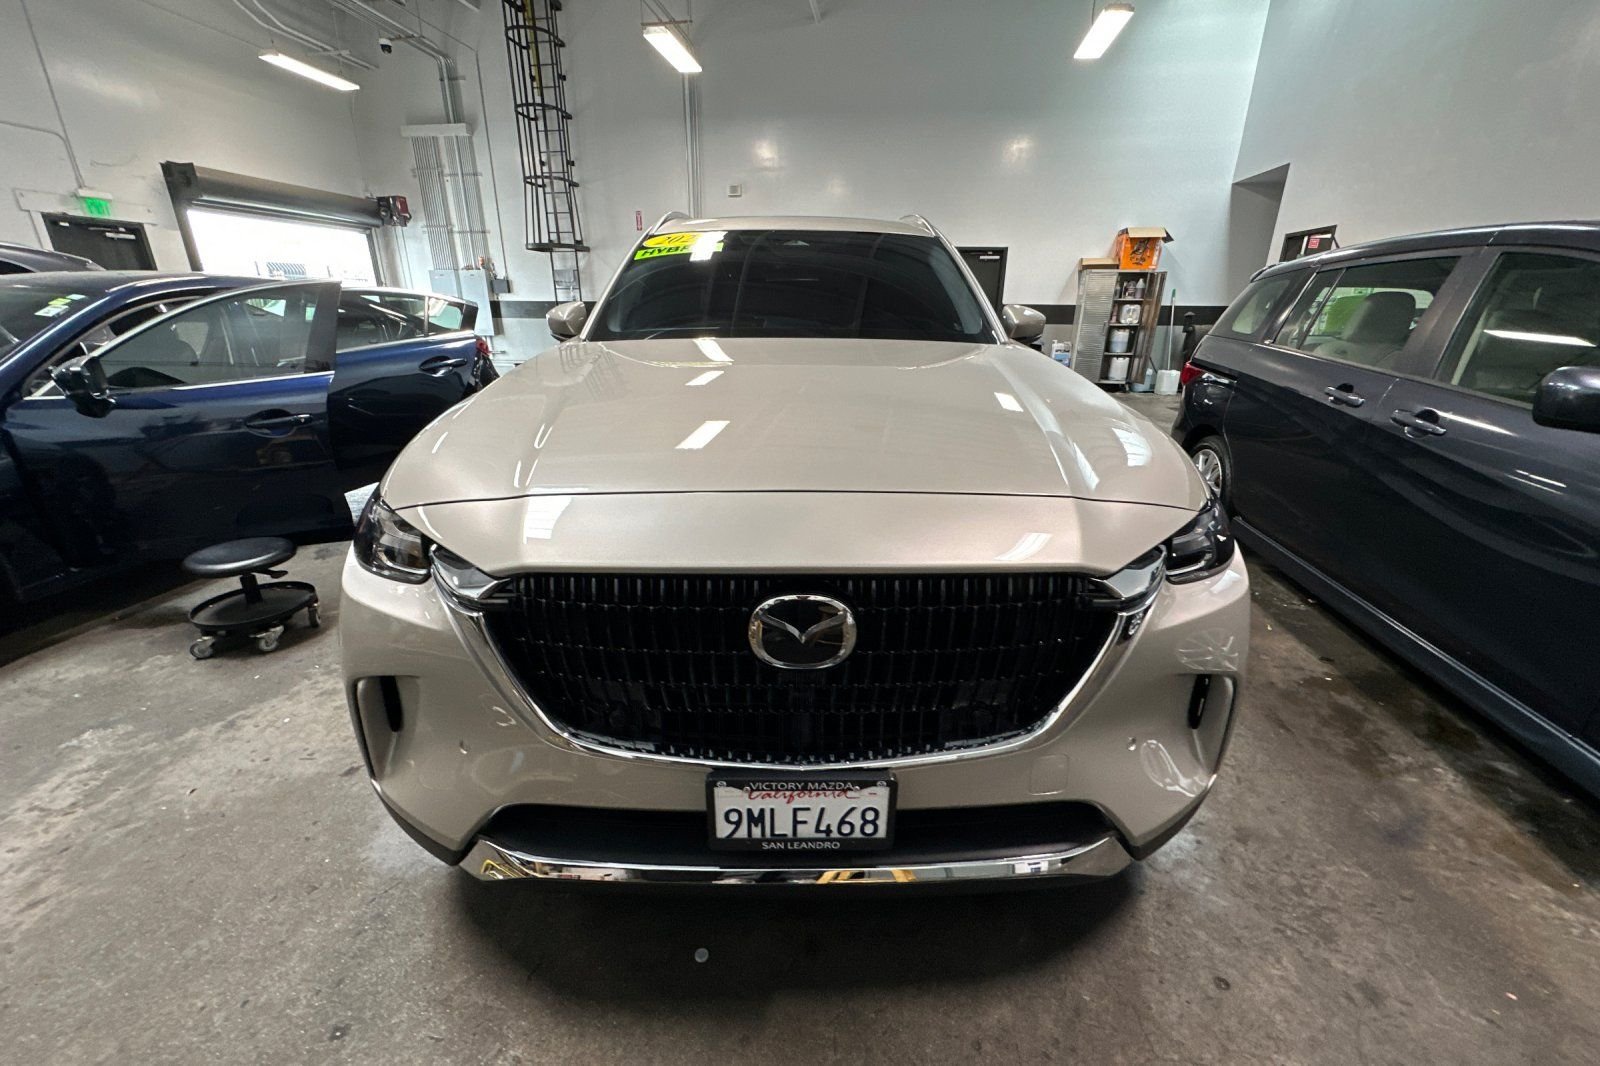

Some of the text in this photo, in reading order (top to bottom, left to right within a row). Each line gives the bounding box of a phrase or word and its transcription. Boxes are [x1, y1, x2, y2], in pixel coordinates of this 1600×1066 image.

[642, 246, 694, 256] HYBR
[750, 782, 854, 790] VICTORY MAZDA
[723, 806, 880, 838] 9MLF468
[761, 841, 841, 850] SAN LEANDRO
